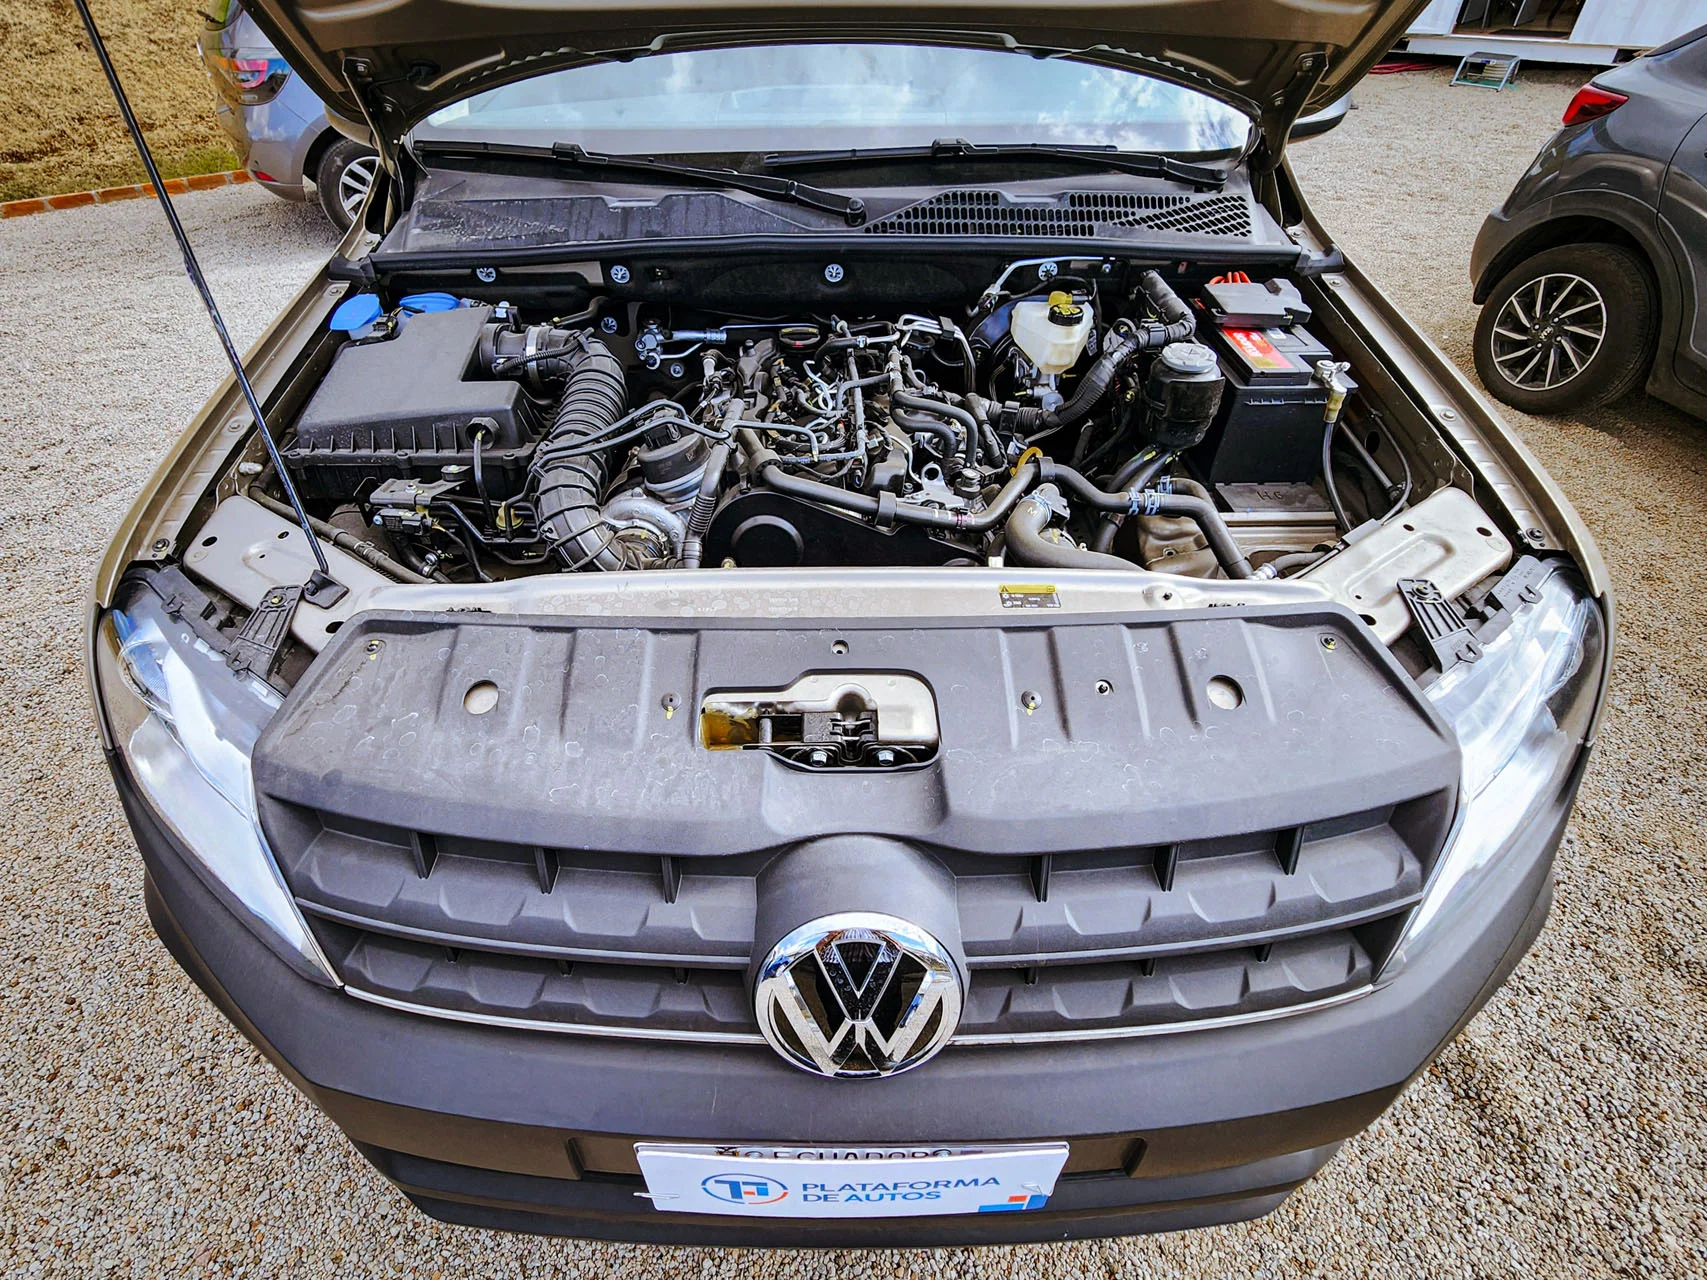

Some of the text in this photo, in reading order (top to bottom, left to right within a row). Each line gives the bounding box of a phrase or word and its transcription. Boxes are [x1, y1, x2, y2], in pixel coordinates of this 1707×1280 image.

[802, 1177, 1001, 1192] PLATAFORMA
[802, 1191, 942, 1203] DE AUTOS
